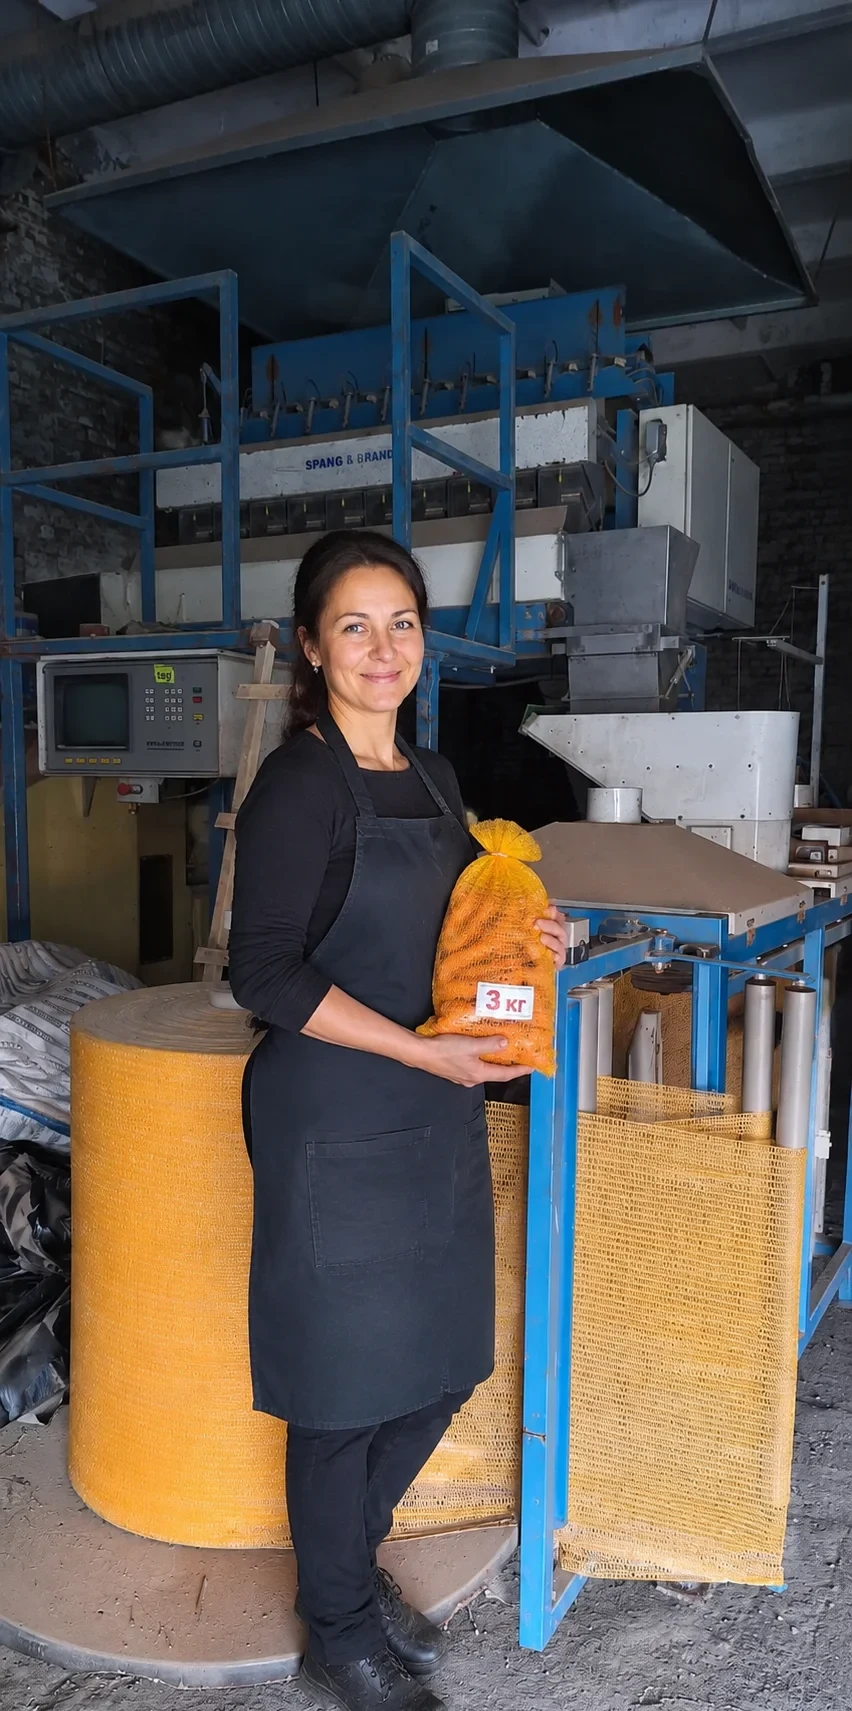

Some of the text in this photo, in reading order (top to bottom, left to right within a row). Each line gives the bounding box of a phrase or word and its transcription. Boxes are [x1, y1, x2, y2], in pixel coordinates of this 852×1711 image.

[305, 456, 343, 470] SPANG
[485, 989, 527, 1013] 3 кг
